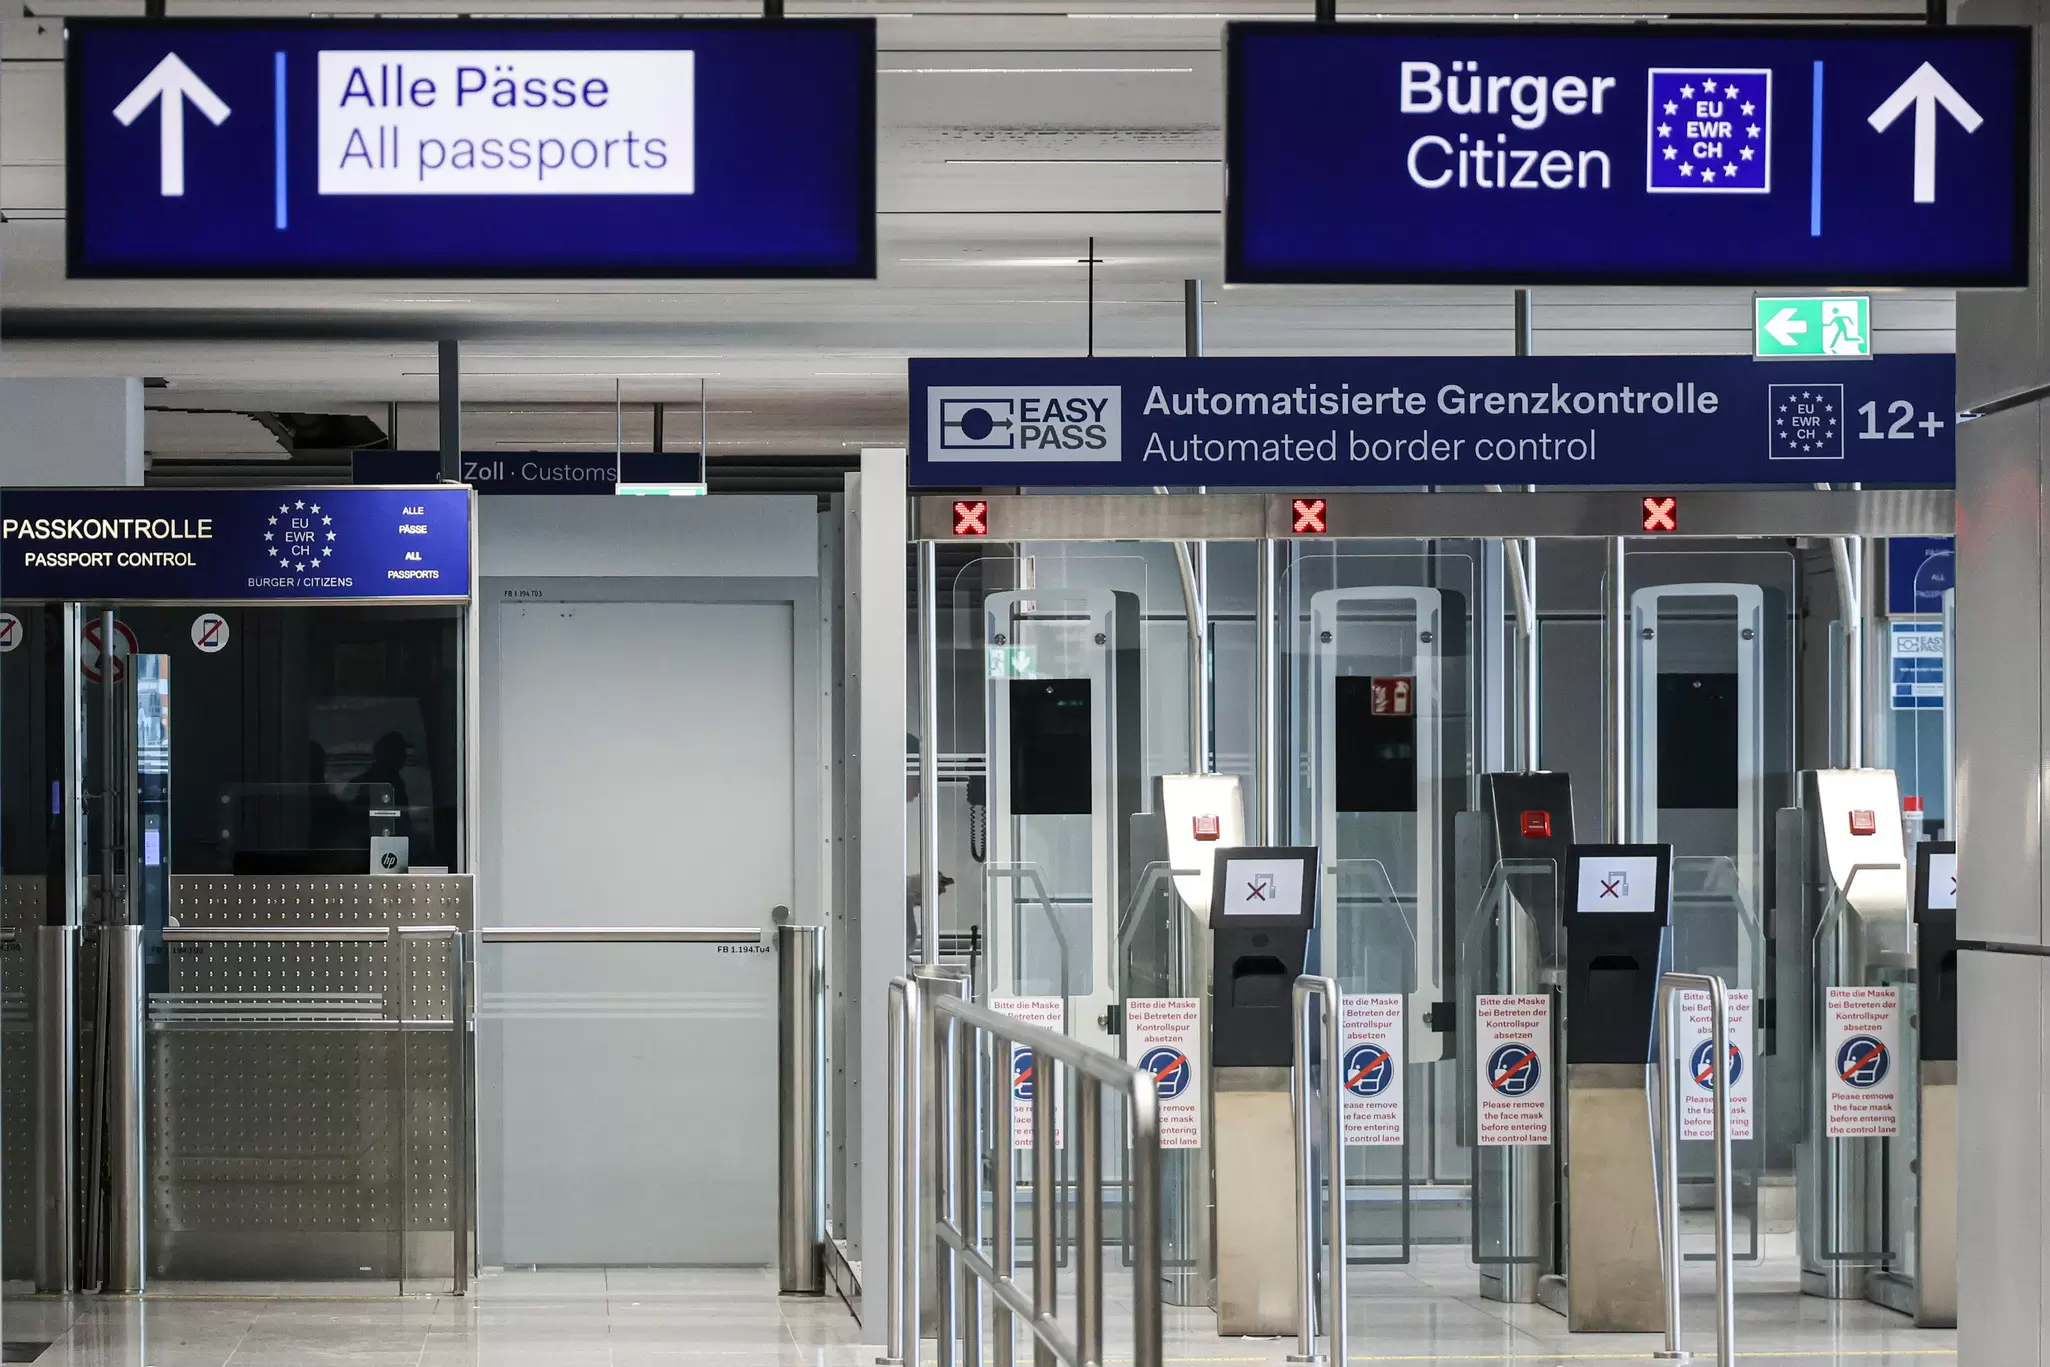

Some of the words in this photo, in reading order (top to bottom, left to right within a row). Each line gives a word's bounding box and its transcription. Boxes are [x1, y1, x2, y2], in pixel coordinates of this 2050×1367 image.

[339, 64, 437, 107] Alle
[457, 65, 609, 108] Pässe
[1400, 61, 1616, 130] Bürger
[1696, 101, 1723, 117] EU
[1686, 121, 1732, 138] EWR
[339, 125, 398, 169] All
[419, 130, 668, 181] passports
[1693, 142, 1723, 159] CH
[1407, 133, 1611, 188] Citizen
[1143, 384, 1426, 415] Automatisierte
[1437, 383, 1719, 414] Grenzkontrolle
[1020, 398, 1109, 423] EASY
[1798, 404, 1814, 414] EU
[1792, 417, 1820, 427] EWR
[1858, 400, 1944, 439] 12+
[1020, 425, 1107, 450] PASS
[1797, 429, 1815, 439] CH
[1143, 430, 1337, 462] Automated
[1350, 430, 1465, 461] border
[1475, 429, 1596, 461] control
[464, 462, 504, 480] Zoll
[521, 462, 617, 481] Customs
[402, 507, 424, 515] ALLE
[292, 518, 309, 529] EU
[399, 523, 427, 534] PÄSSE
[3, 519, 213, 539] PASSKONTROLLE
[285, 532, 315, 542] EWR
[291, 545, 310, 556] CH
[25, 553, 113, 566] PASSPORT
[117, 552, 196, 567] CONTROL
[405, 552, 422, 561] ALL
[388, 570, 439, 579] PASSPORTS
[248, 577, 294, 587] BÜRGER
[303, 578, 353, 587] CITIZENS
[1683, 992, 1704, 1000] Bitte
[994, 1001, 1015, 1009] Bitte
[1016, 1001, 1030, 1009] die
[1031, 1001, 1060, 1009] Maske
[1130, 1001, 1151, 1009] Bitte
[1152, 1001, 1166, 1009] die
[1168, 1001, 1196, 1009] Maske
[1046, 1012, 1061, 1020] der
[1128, 1012, 1142, 1020] bei
[1144, 1012, 1182, 1020] Betreten
[1183, 1011, 1198, 1020] der
[1346, 1009, 1384, 1017] Betreten
[1836, 1012, 1889, 1021] Kontrollspur
[1136, 1023, 1190, 1032] Kontrollspur
[1486, 1020, 1540, 1028] Kontrollspur
[1831, 1092, 1861, 1100] Please
[1170, 1114, 1194, 1123] mask
[1353, 1112, 1372, 1120] face
[1373, 1112, 1397, 1120] mask
[1484, 1112, 1499, 1120] the
[1859, 1115, 1896, 1123] entering
[1344, 1123, 1362, 1131] fore
[1363, 1123, 1400, 1132] entering
[1511, 1122, 1547, 1132] entering
[1179, 1137, 1198, 1145] lane
